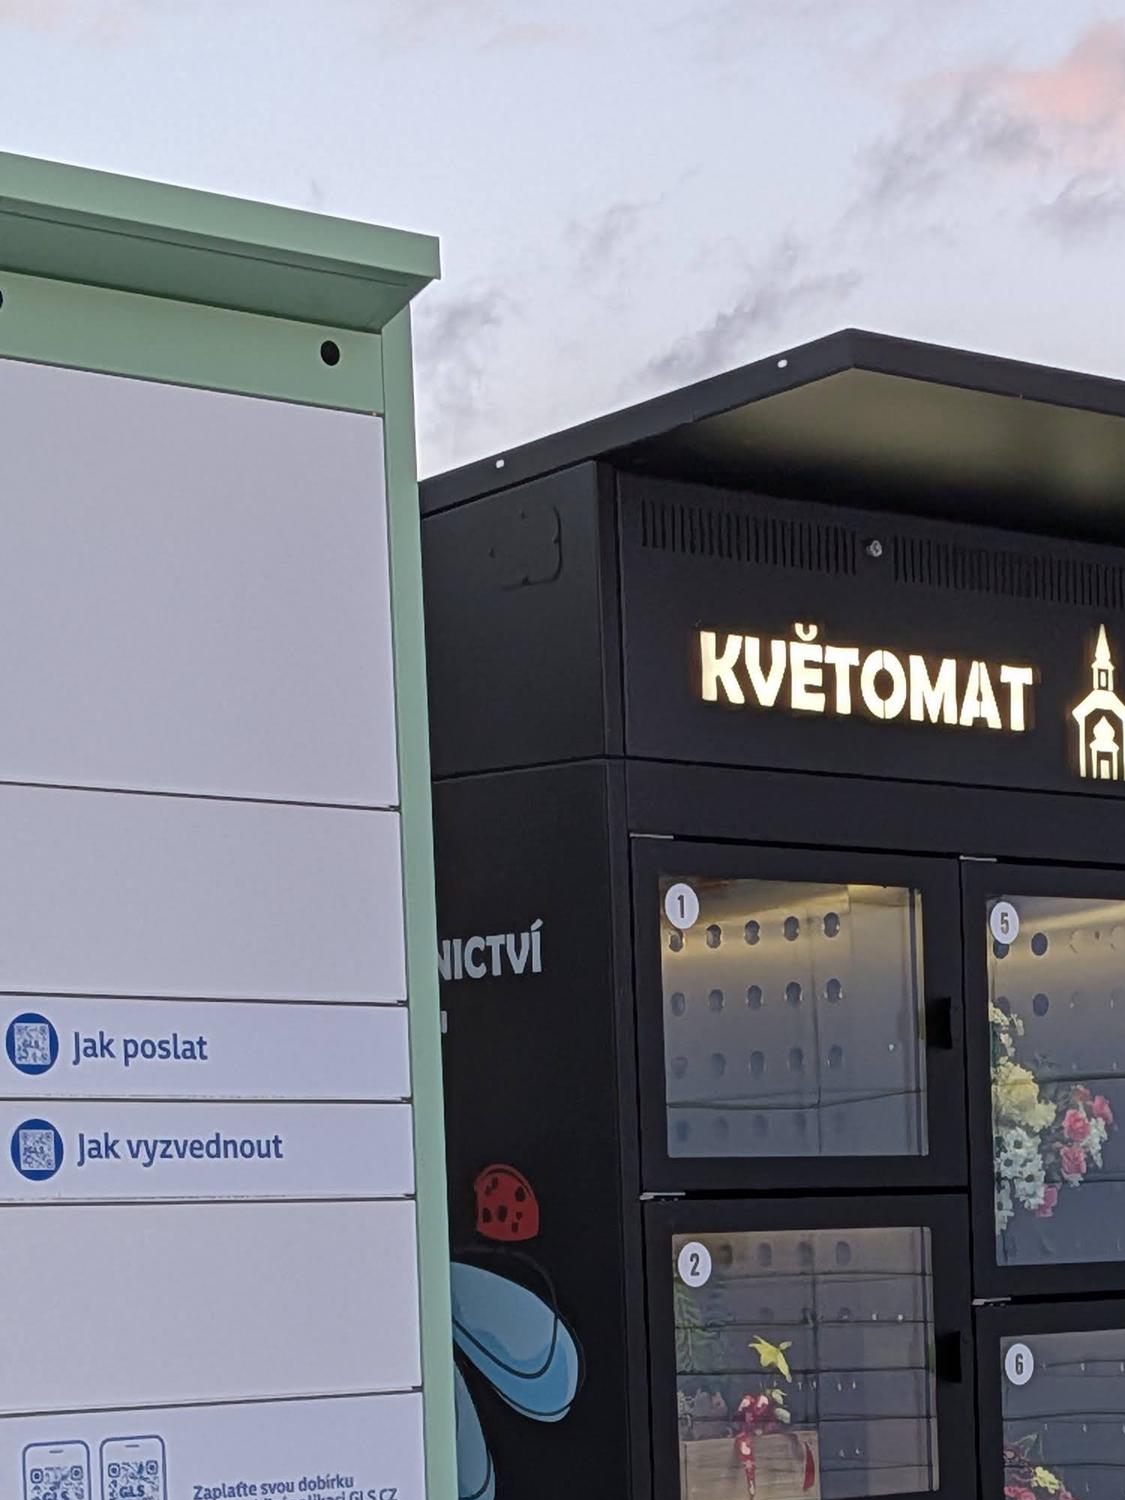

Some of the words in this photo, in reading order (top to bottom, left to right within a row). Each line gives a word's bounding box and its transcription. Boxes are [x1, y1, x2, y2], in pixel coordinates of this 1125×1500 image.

[700, 622, 1033, 732] KVĚTOMAT
[676, 894, 686, 919] 1
[999, 911, 1009, 935] 5
[72, 1032, 115, 1066] Jak
[123, 1032, 208, 1067] poslat
[77, 1132, 120, 1167] Jak
[127, 1132, 283, 1168] vyzvednout
[689, 1252, 700, 1277] 2
[1014, 1353, 1024, 1376] 6
[119, 1485, 145, 1498] GLS
[260, 1479, 295, 1495] svou
[298, 1473, 354, 1492] dobírku
